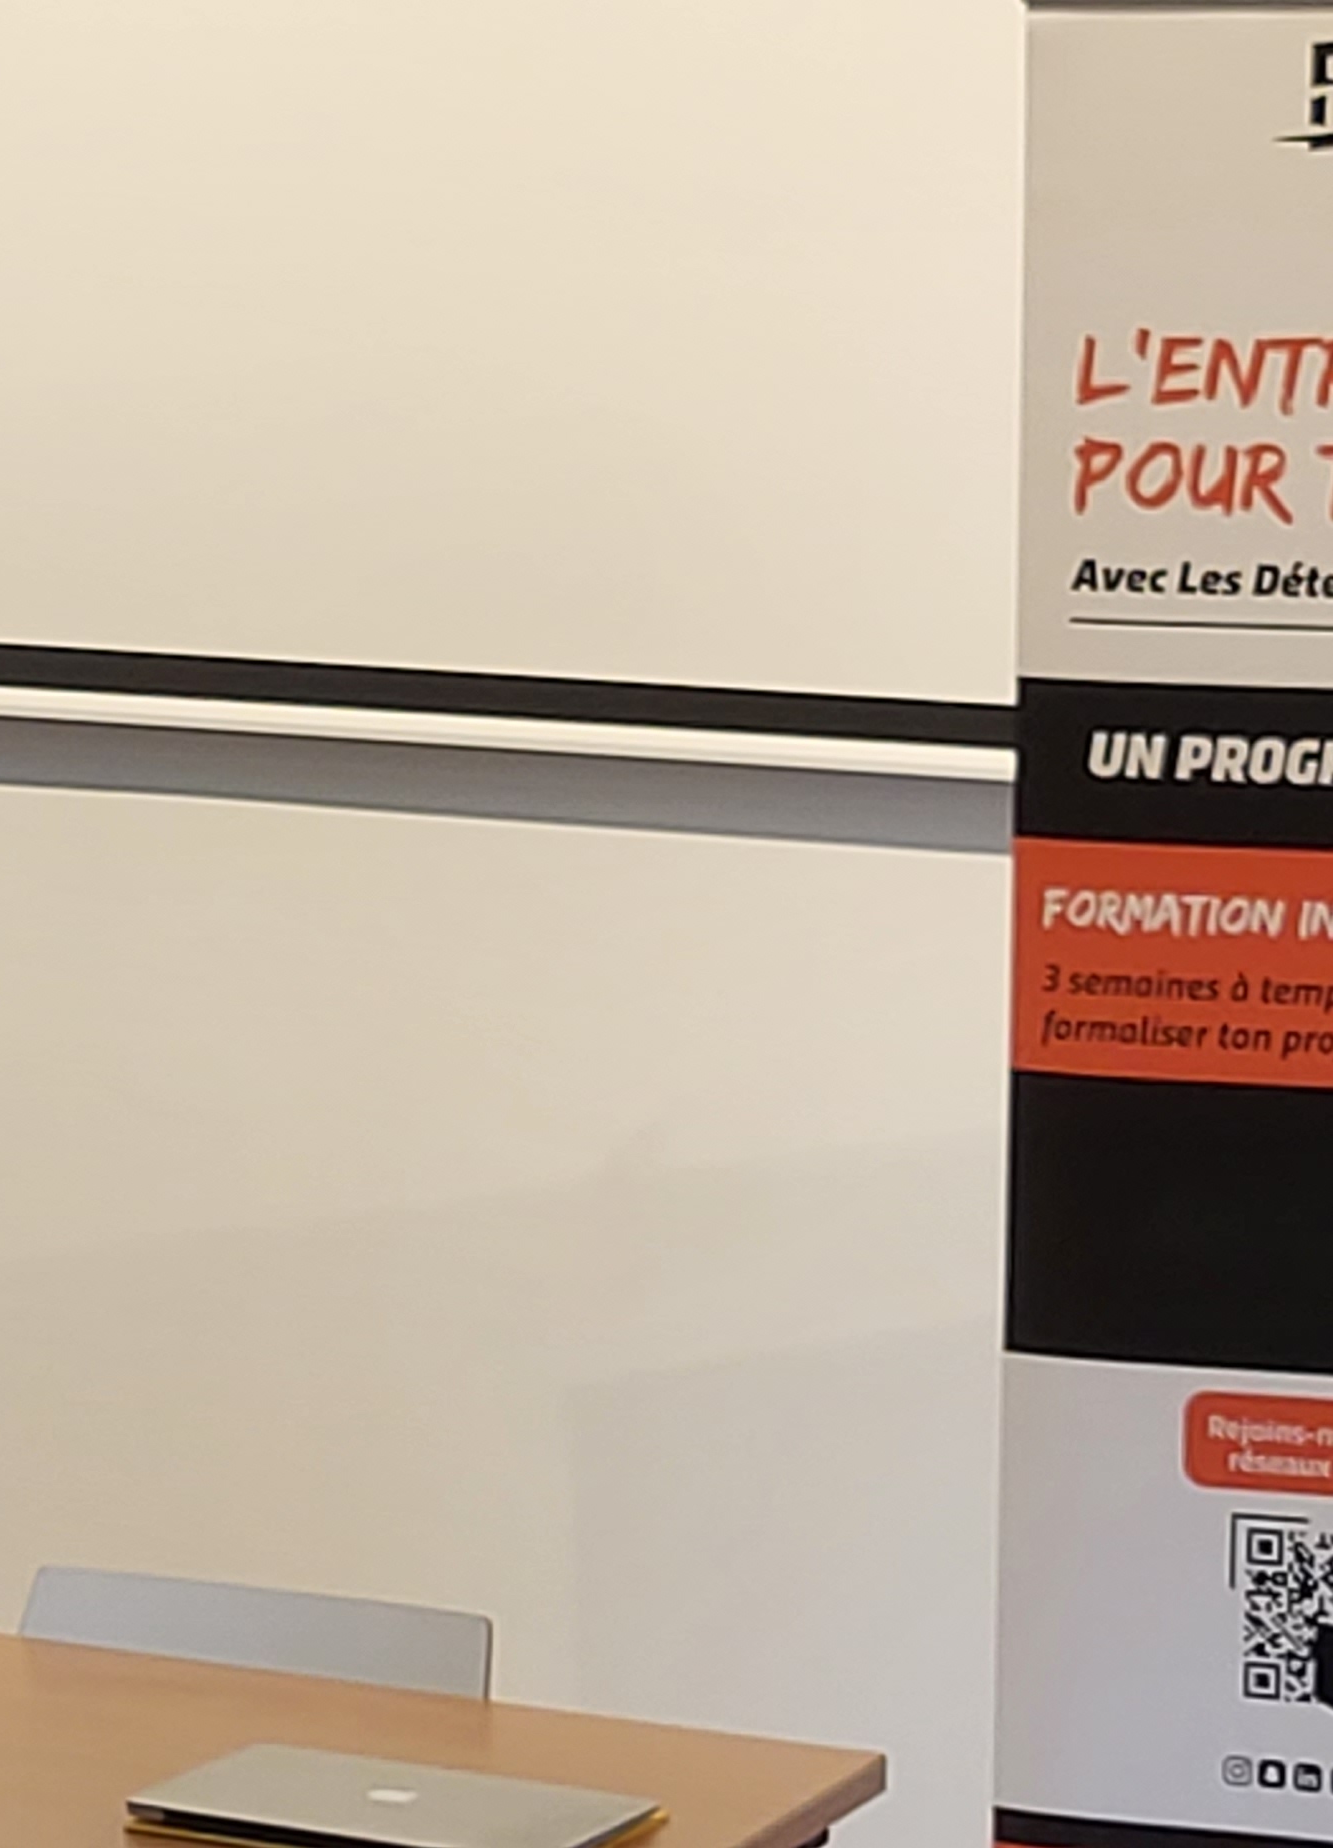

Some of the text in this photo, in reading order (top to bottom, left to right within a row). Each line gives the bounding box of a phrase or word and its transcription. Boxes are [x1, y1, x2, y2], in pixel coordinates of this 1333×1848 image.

[1074, 437, 1293, 524] POUR
[1070, 558, 1169, 593] Avec
[1177, 560, 1242, 596] Les
[1088, 732, 1167, 781] UN
[1042, 889, 1287, 937] FORMATION
[1042, 964, 1061, 992] 3
[1067, 970, 1220, 1001] semaines
[1229, 972, 1249, 1002] à
[1041, 1009, 1209, 1048] formaliser
[1218, 1022, 1271, 1051] ton
